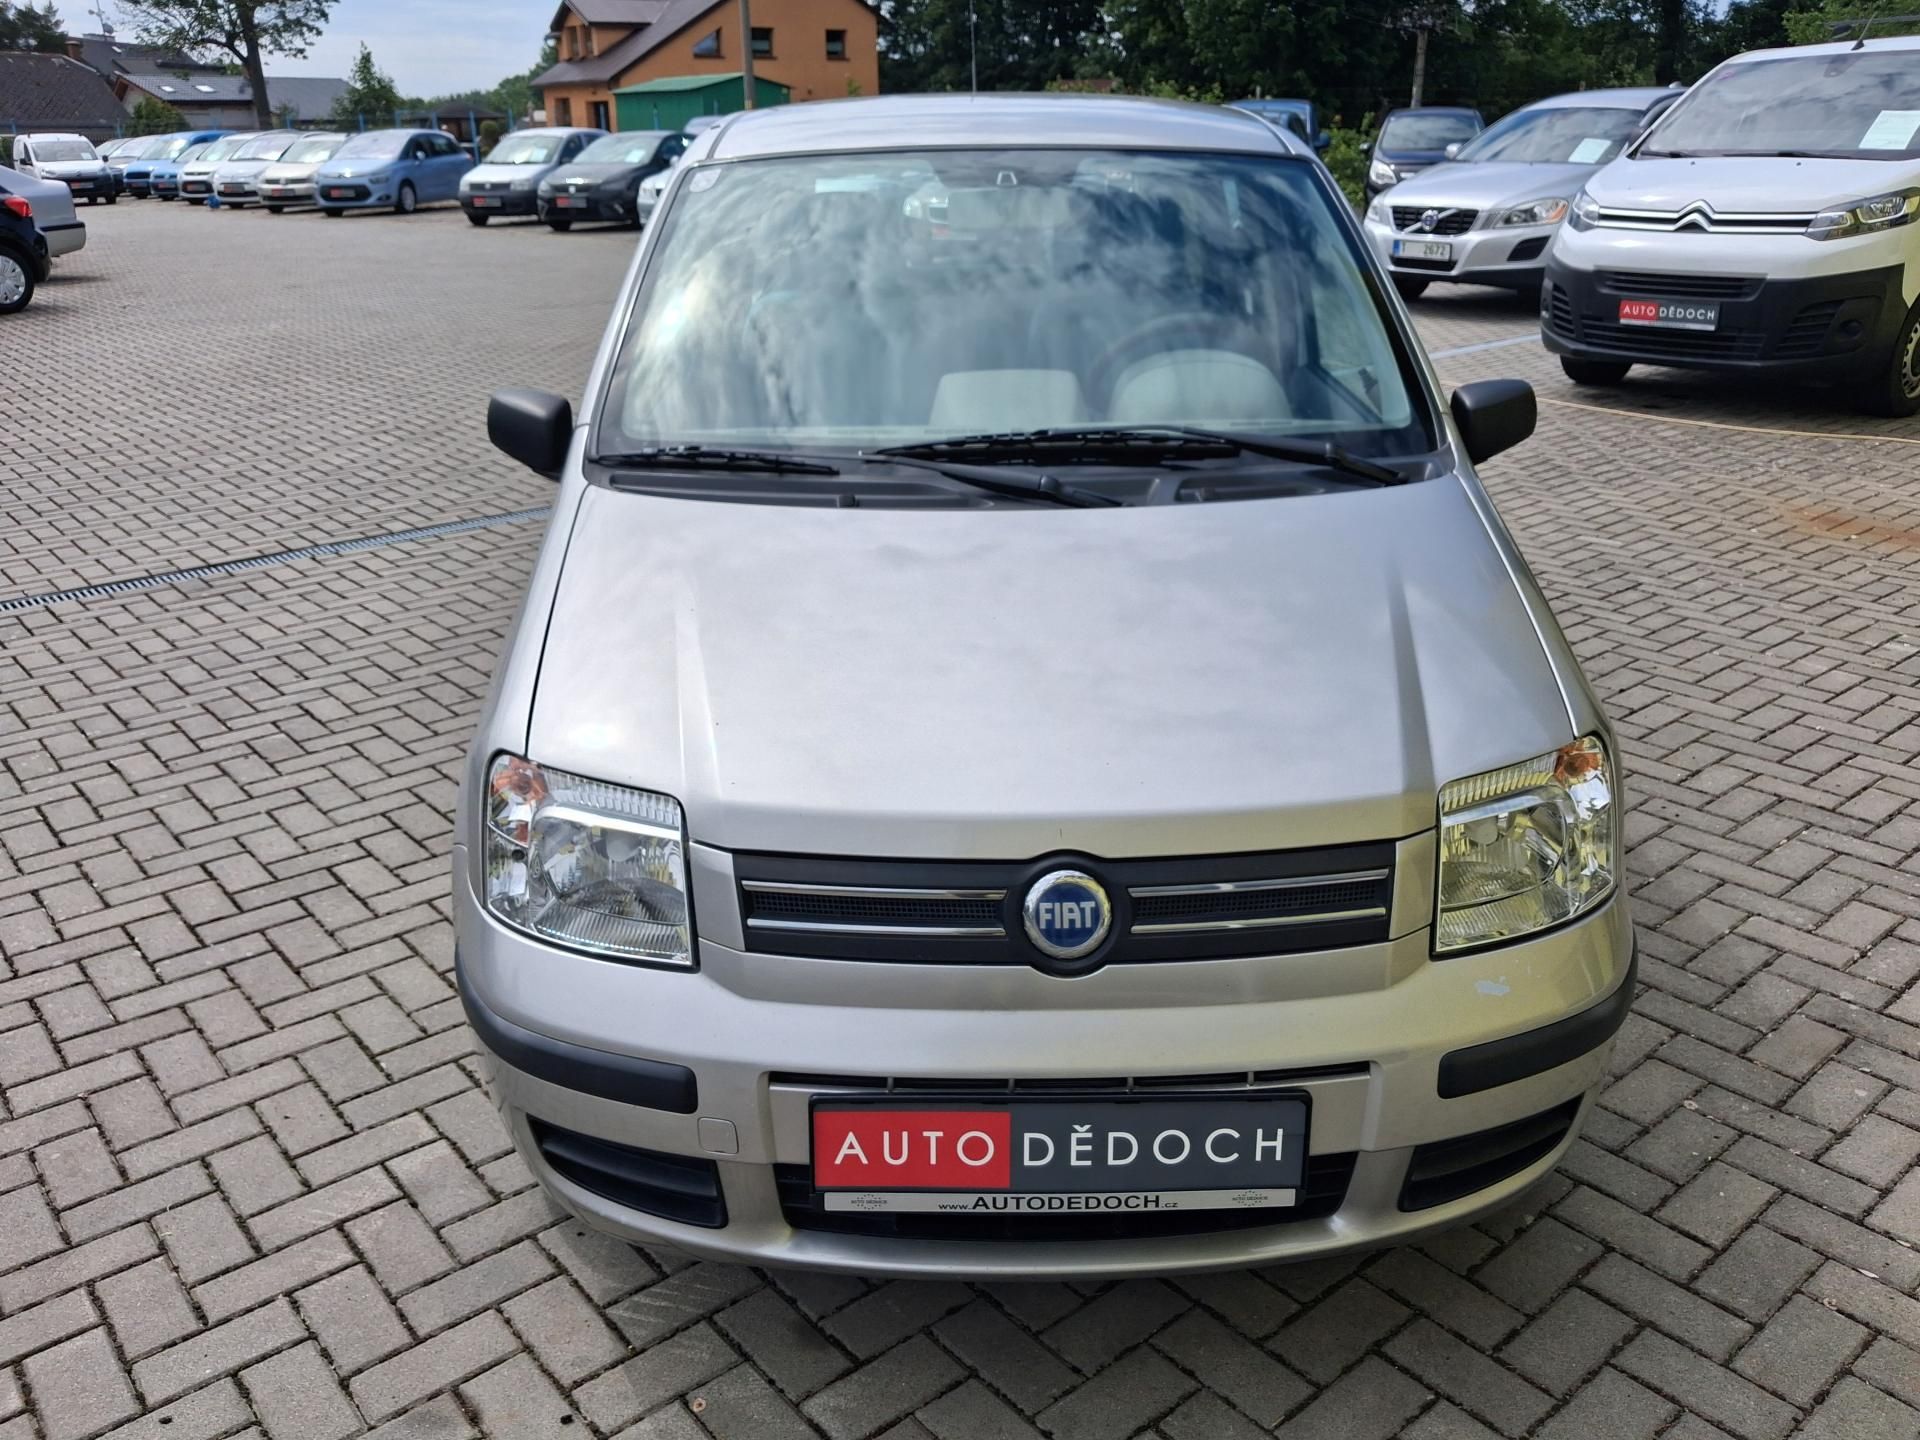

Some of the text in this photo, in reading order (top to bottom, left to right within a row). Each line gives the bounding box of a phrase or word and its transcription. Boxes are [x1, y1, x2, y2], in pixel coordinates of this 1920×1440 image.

[1623, 304, 1716, 321] AUTO DĚDOCH
[1038, 901, 1096, 930] FIAT
[834, 1124, 1284, 1167] AUTO DĚDOCH
[938, 1194, 1179, 1211] www.AUTODEDOCH.cz
